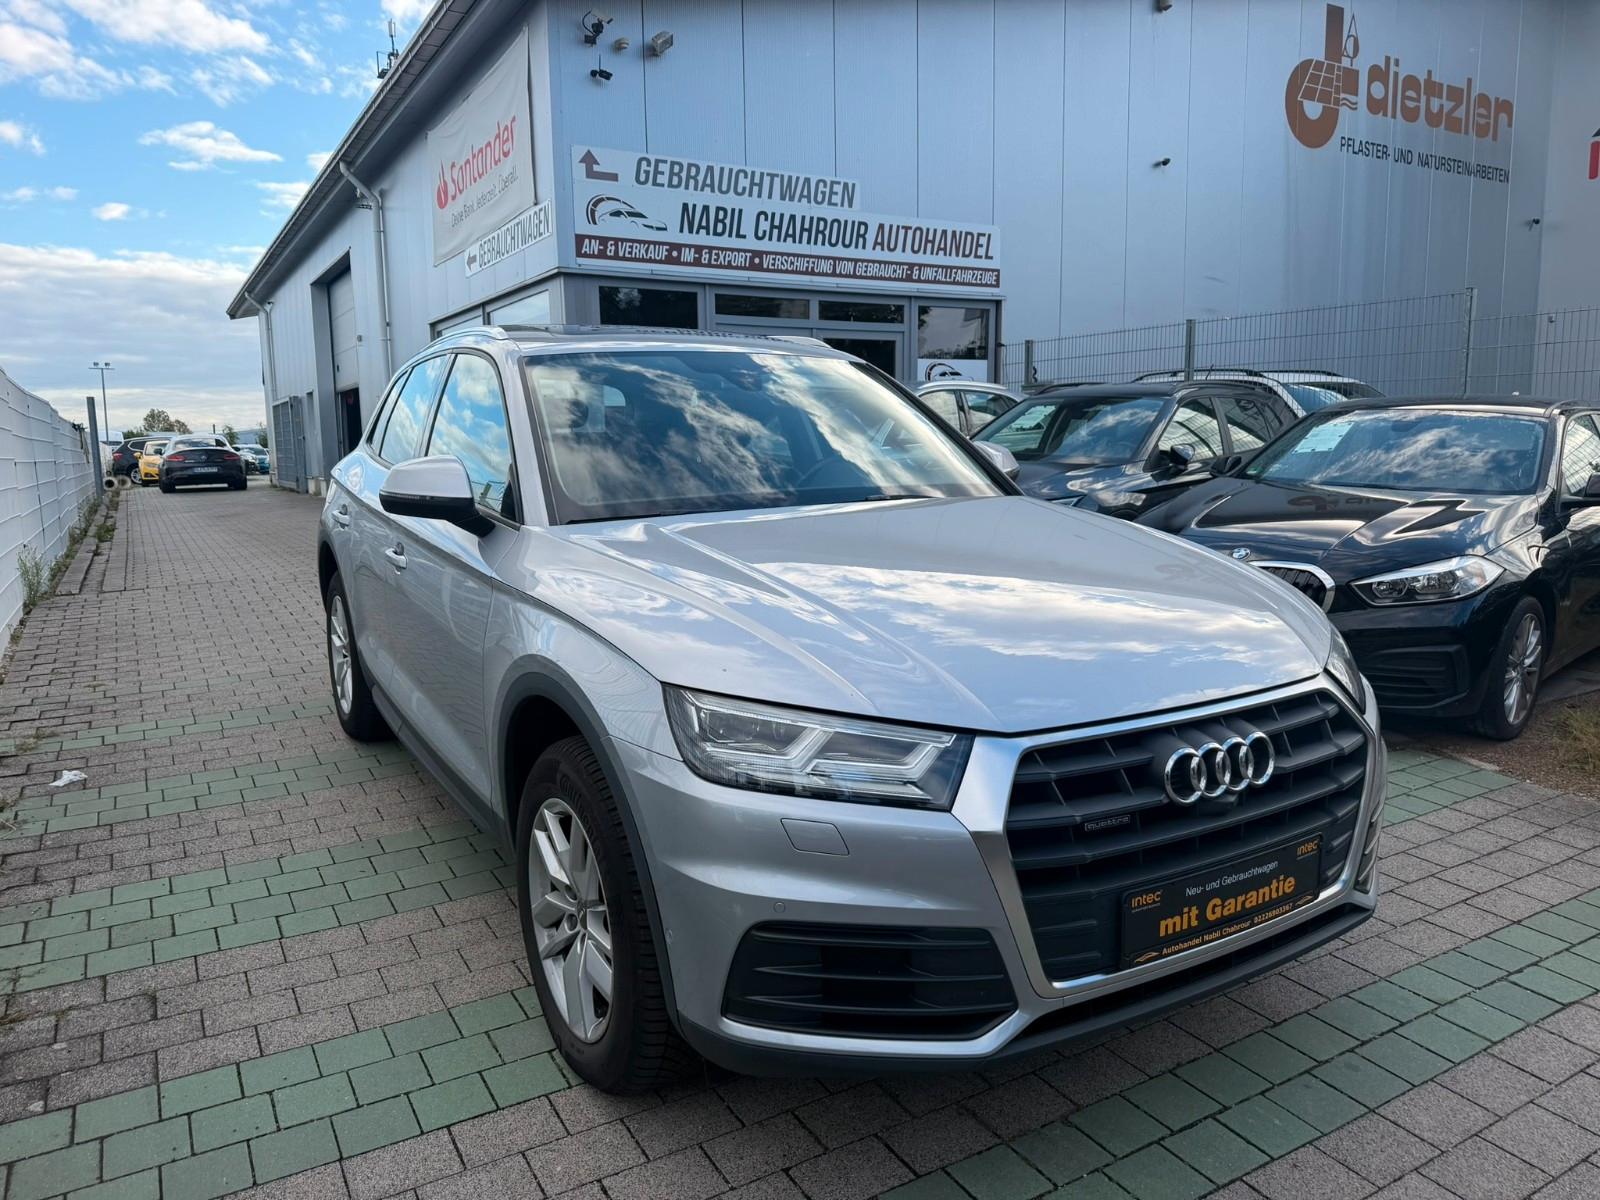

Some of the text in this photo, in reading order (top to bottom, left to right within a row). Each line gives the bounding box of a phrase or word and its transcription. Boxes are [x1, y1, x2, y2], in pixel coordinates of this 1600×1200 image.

[1366, 55, 1514, 141] dietzler
[450, 115, 516, 200] Santander
[635, 156, 856, 208] GEBRAUCHTWAGEN
[1340, 136, 1510, 184] PFLASTER- UND NATURSTEINARBEITEN
[478, 203, 550, 269] GEBRAUCHTWAGEN
[679, 202, 994, 260] NABIL CHAHROUR AUTOHANDEL
[582, 238, 998, 285] AN- & VERKAUF IM- & EXPORT VERSCHIFFUNG VON GEBRAUCHT- & UNFALLFAHRZEUGE
[1205, 878, 1220, 892] und
[1221, 860, 1279, 887] Gebrauchtwagen
[1159, 875, 1296, 937] mit Garantie
[1162, 936, 1202, 955] Autohandel
